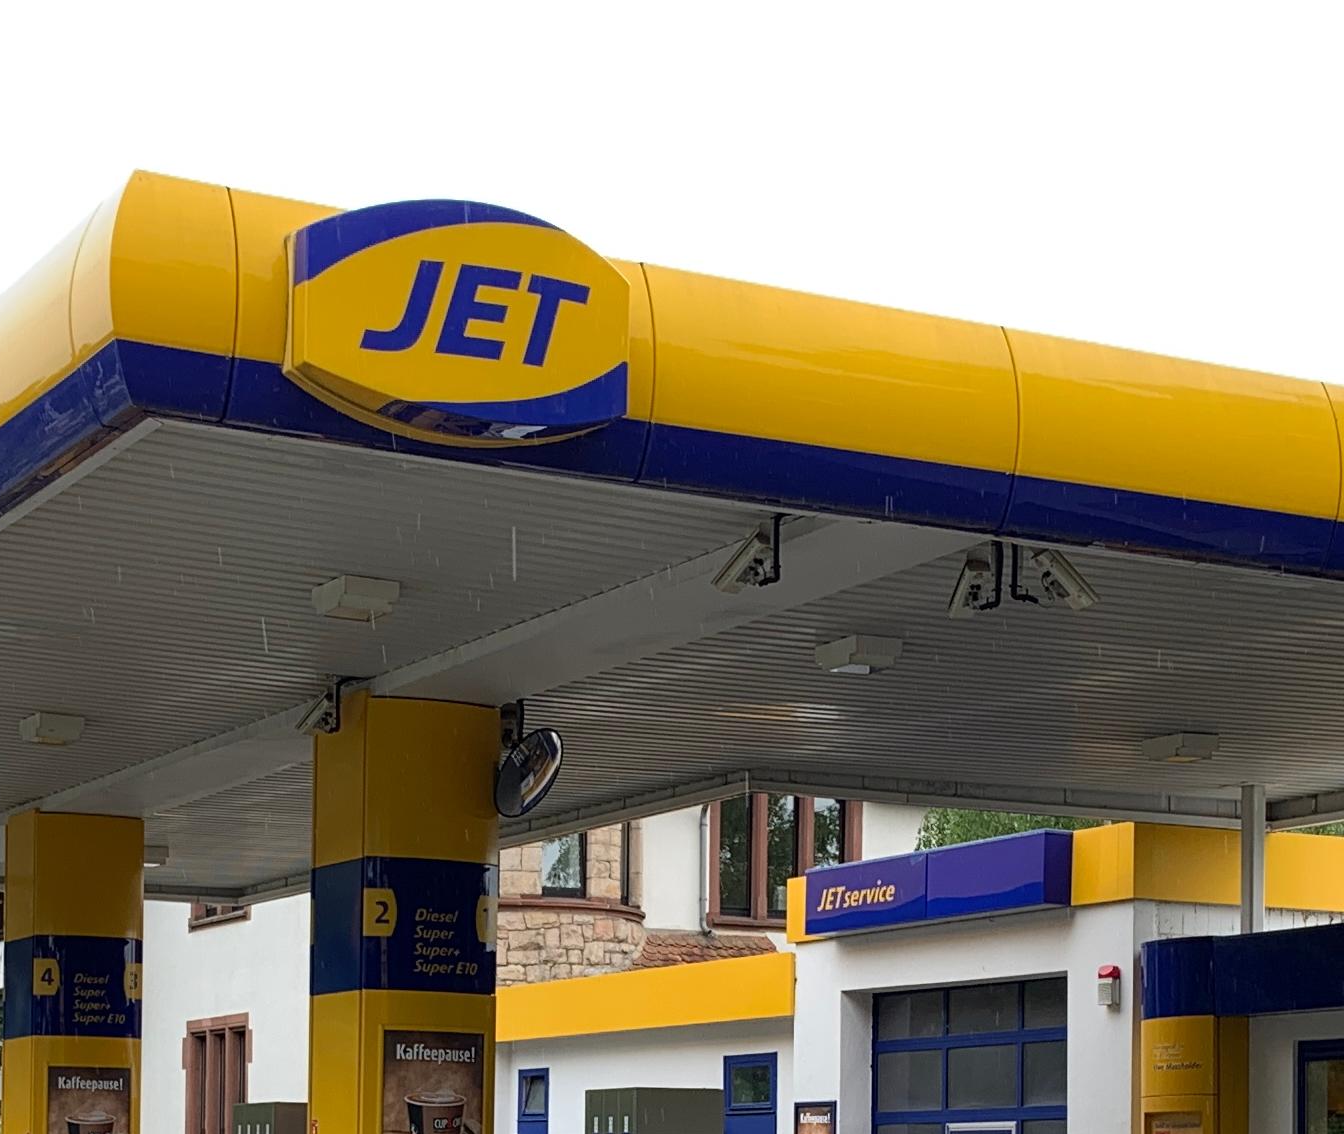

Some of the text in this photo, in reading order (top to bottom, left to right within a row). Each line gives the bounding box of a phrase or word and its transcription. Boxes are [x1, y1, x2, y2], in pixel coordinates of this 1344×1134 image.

[359, 259, 591, 367] JET
[375, 901, 390, 924] 2
[415, 908, 458, 923] Diesel
[413, 925, 454, 942] Super
[413, 943, 460, 959] Super+
[413, 959, 478, 976] Super E10
[41, 967, 55, 986] 4
[73, 973, 110, 985] Diesel
[73, 987, 106, 999] Super
[72, 1012, 126, 1025] Super E10
[396, 1043, 476, 1064] Kaffeepause!
[58, 1076, 123, 1092] Kaffeepause!
